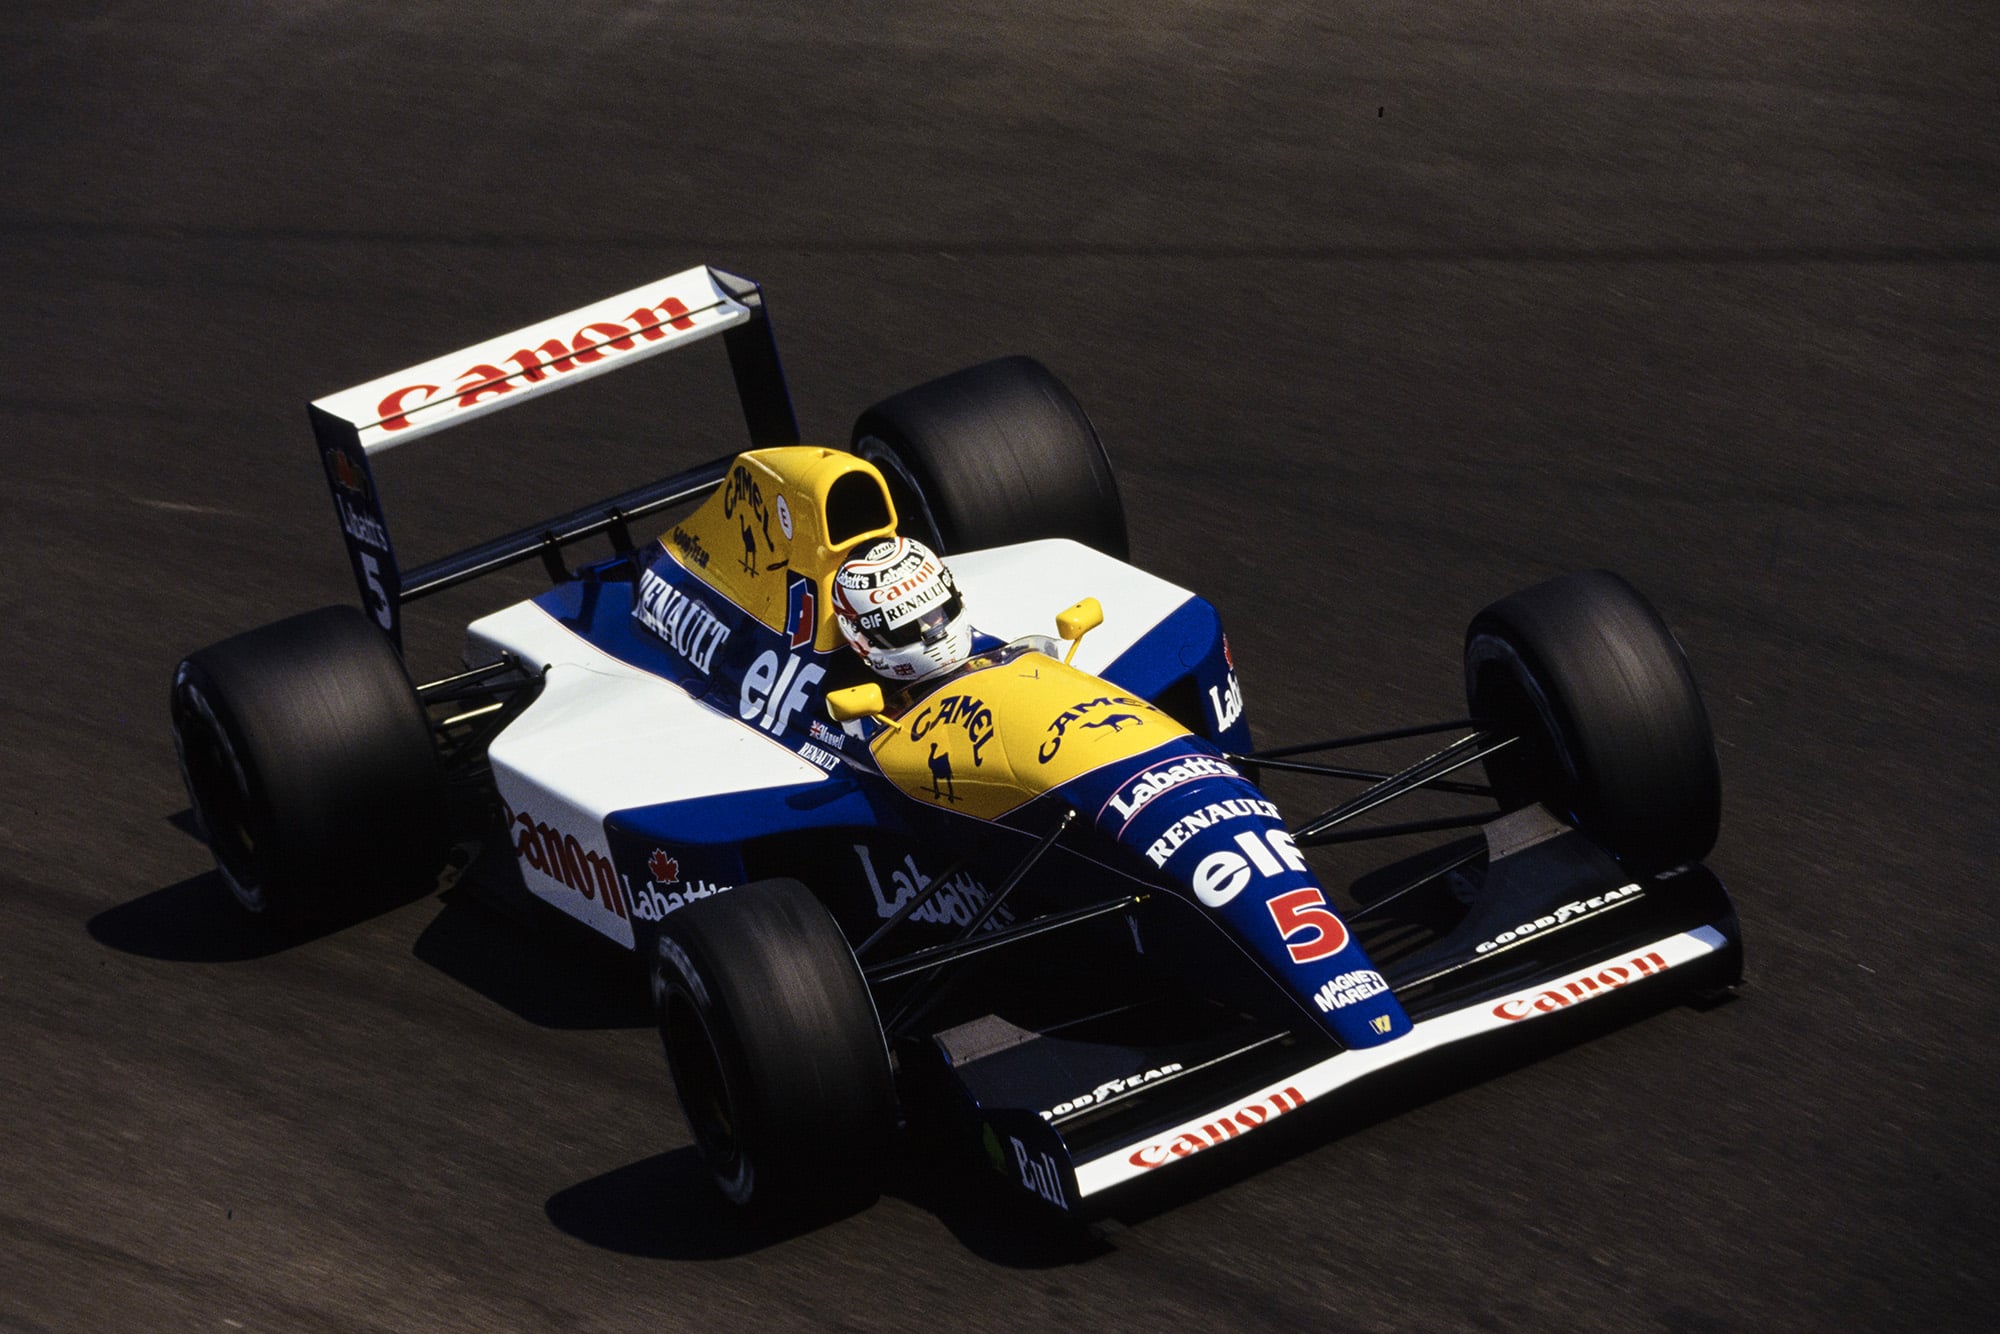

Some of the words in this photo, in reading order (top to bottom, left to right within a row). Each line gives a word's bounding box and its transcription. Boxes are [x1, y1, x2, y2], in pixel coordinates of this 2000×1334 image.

[377, 297, 697, 432] Canon
[724, 465, 775, 552] CAMEL
[360, 551, 393, 631] 5
[869, 561, 935, 605] Canon
[885, 582, 945, 622] RENAULT
[631, 568, 732, 676] RENAULT
[860, 612, 883, 631] elf
[739, 649, 827, 737] elf
[797, 741, 841, 771] RENAULT
[910, 695, 994, 768] CAMEL
[1109, 757, 1240, 821] Labatt's
[1145, 798, 1283, 870] RENAULT
[1192, 828, 1308, 909] elf
[1265, 887, 1350, 965] 5
[1474, 882, 1643, 955] GOODYEAR
[1492, 950, 1669, 1023] Canon
[1128, 1085, 1307, 1169] Canon
